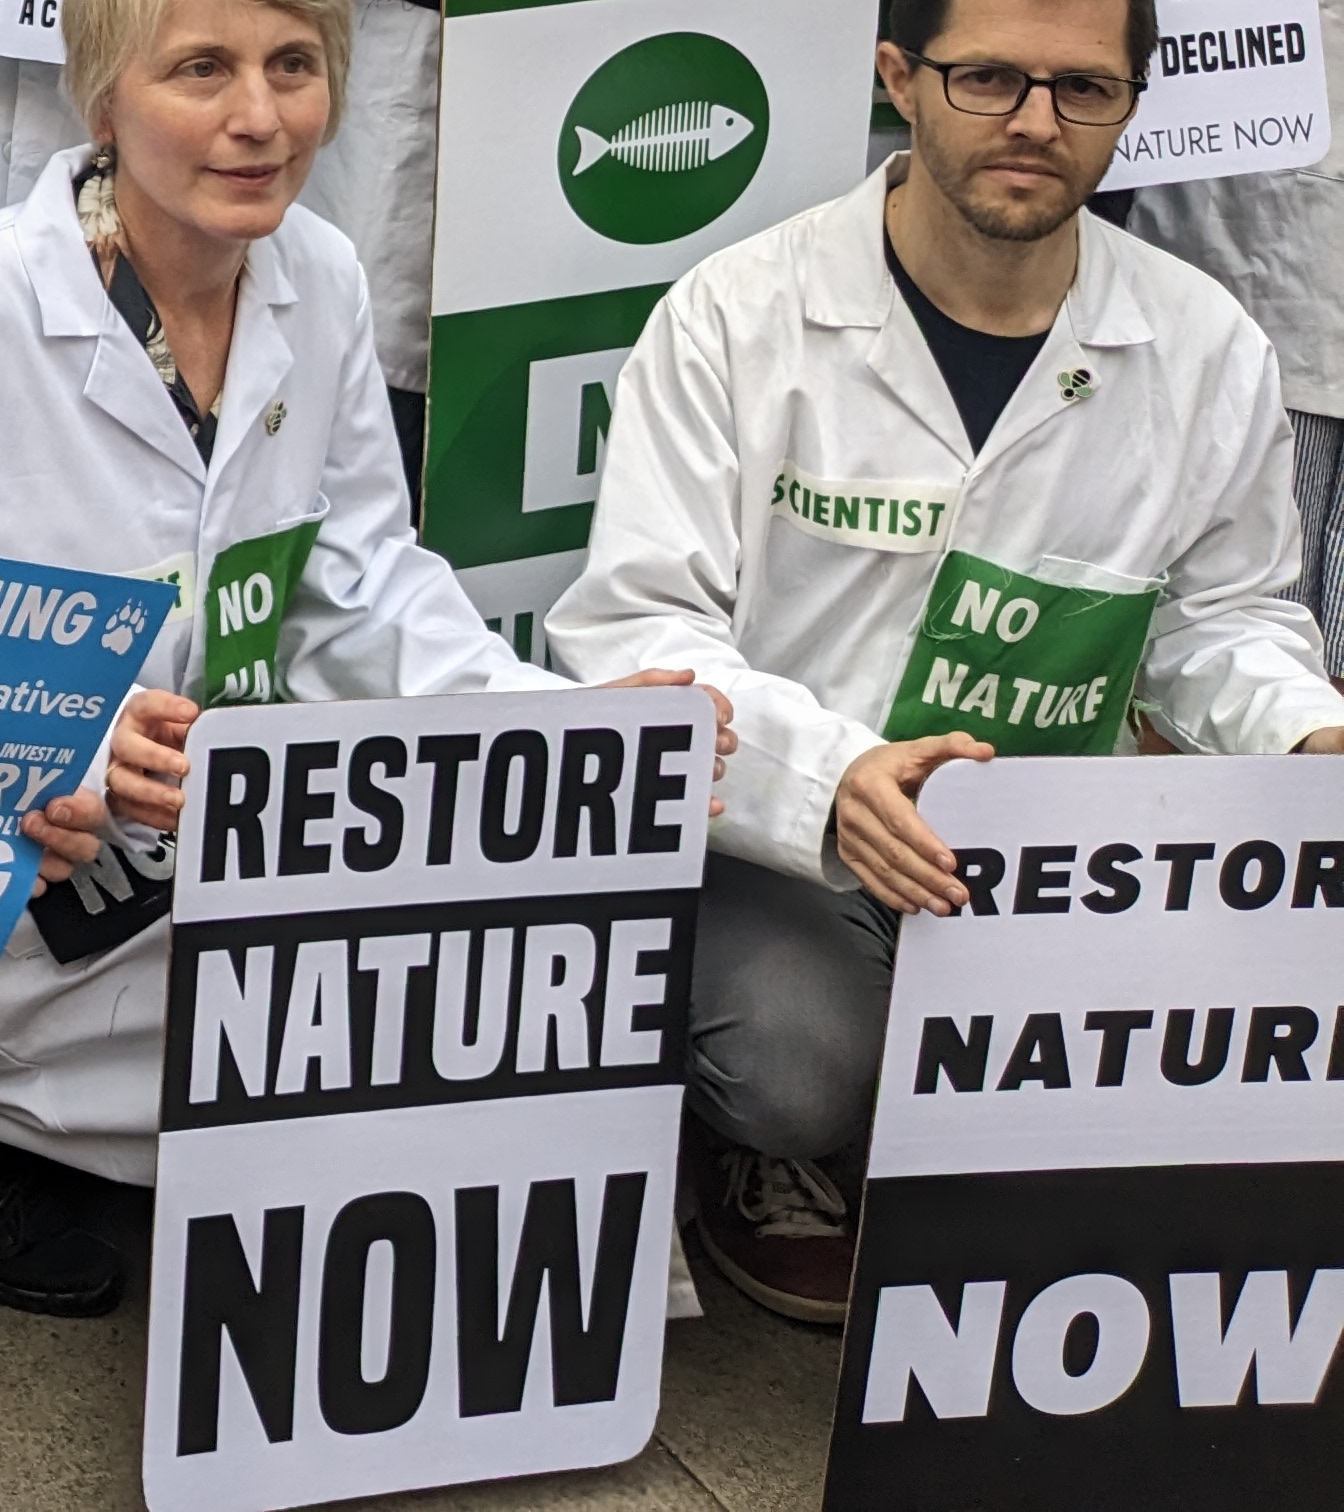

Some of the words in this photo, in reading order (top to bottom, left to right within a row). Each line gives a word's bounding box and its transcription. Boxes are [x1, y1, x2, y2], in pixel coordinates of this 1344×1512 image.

[1161, 23, 1306, 77] DECLINED
[771, 473, 946, 538] SCIENTIST
[219, 572, 273, 637] NO
[951, 580, 1039, 644] NO
[922, 657, 1108, 729] NATURE
[0, 743, 56, 761] INVEST
[54, 748, 75, 764] IN
[200, 724, 692, 883] RESTORE
[188, 918, 672, 1105] NATURE
[176, 1171, 647, 1457] NOW
